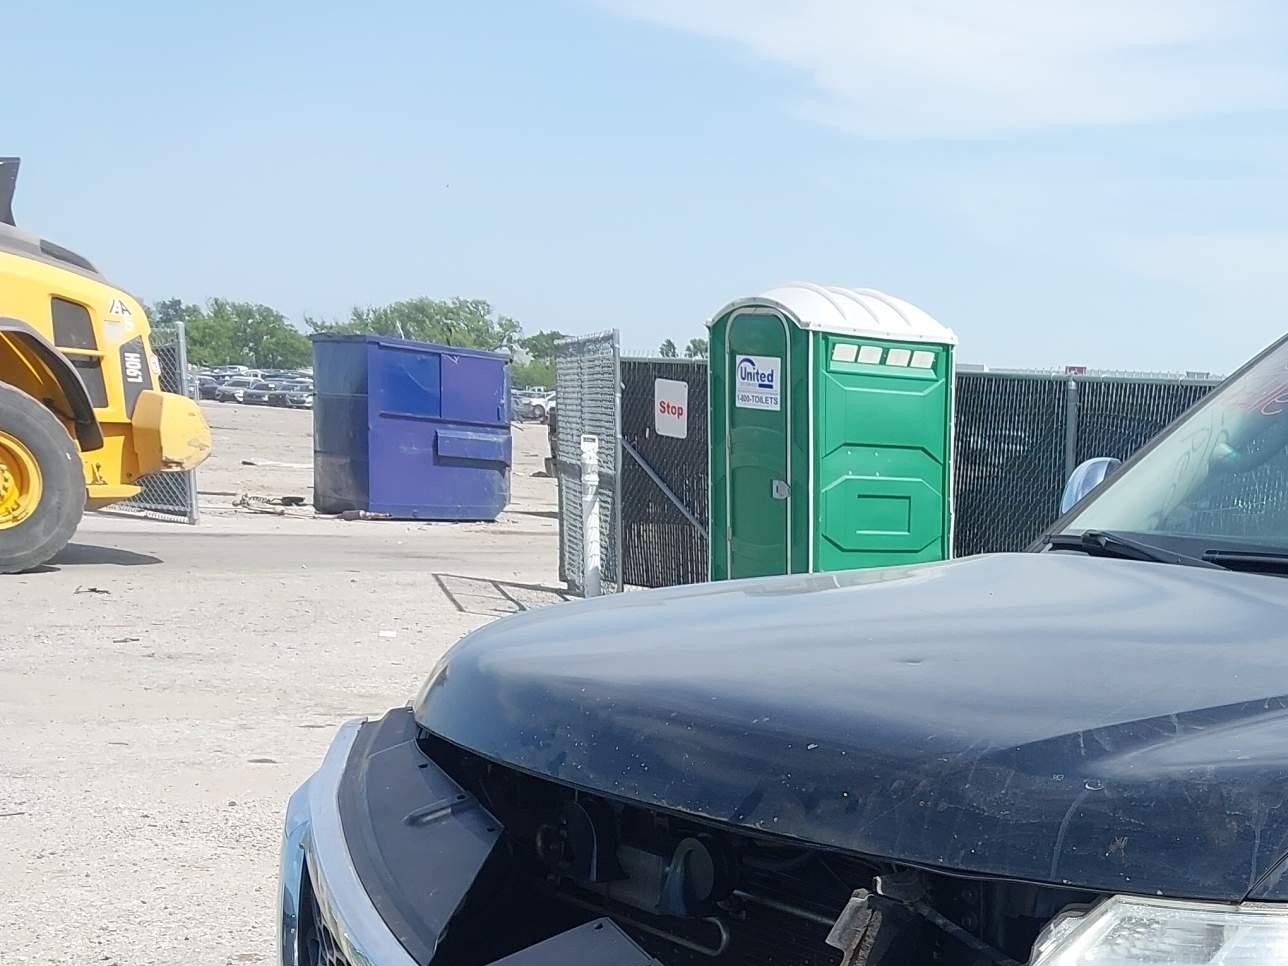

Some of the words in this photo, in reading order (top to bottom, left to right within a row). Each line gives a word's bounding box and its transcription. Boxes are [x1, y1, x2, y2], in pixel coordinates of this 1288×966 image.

[124, 352, 143, 383] L90H
[740, 366, 774, 383] United
[659, 400, 684, 420] Stop
